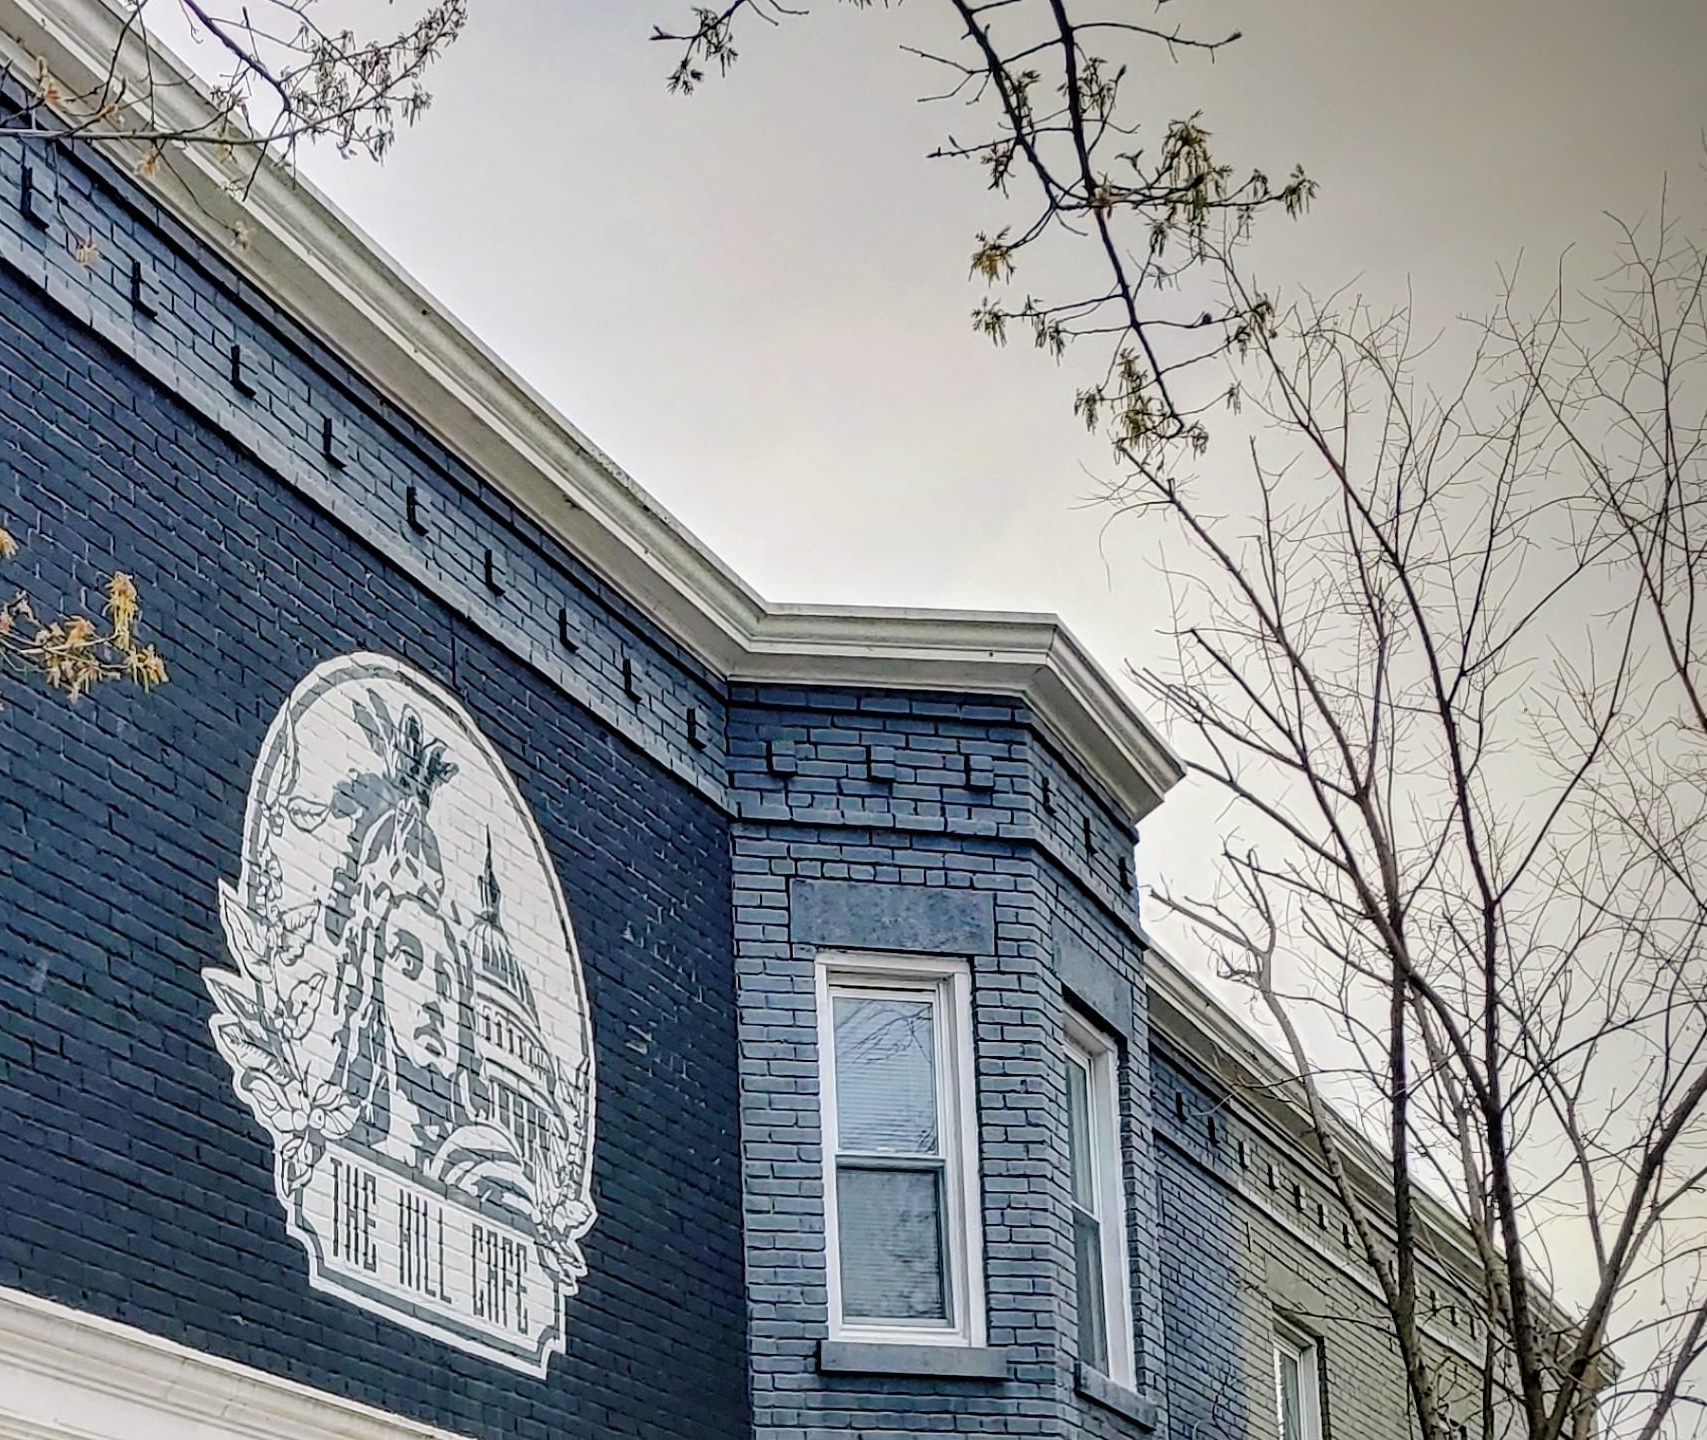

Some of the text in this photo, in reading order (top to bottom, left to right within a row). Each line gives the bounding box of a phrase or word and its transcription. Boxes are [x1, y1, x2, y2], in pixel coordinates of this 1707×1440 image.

[329, 1156, 529, 1336] THE HILL CAFE
